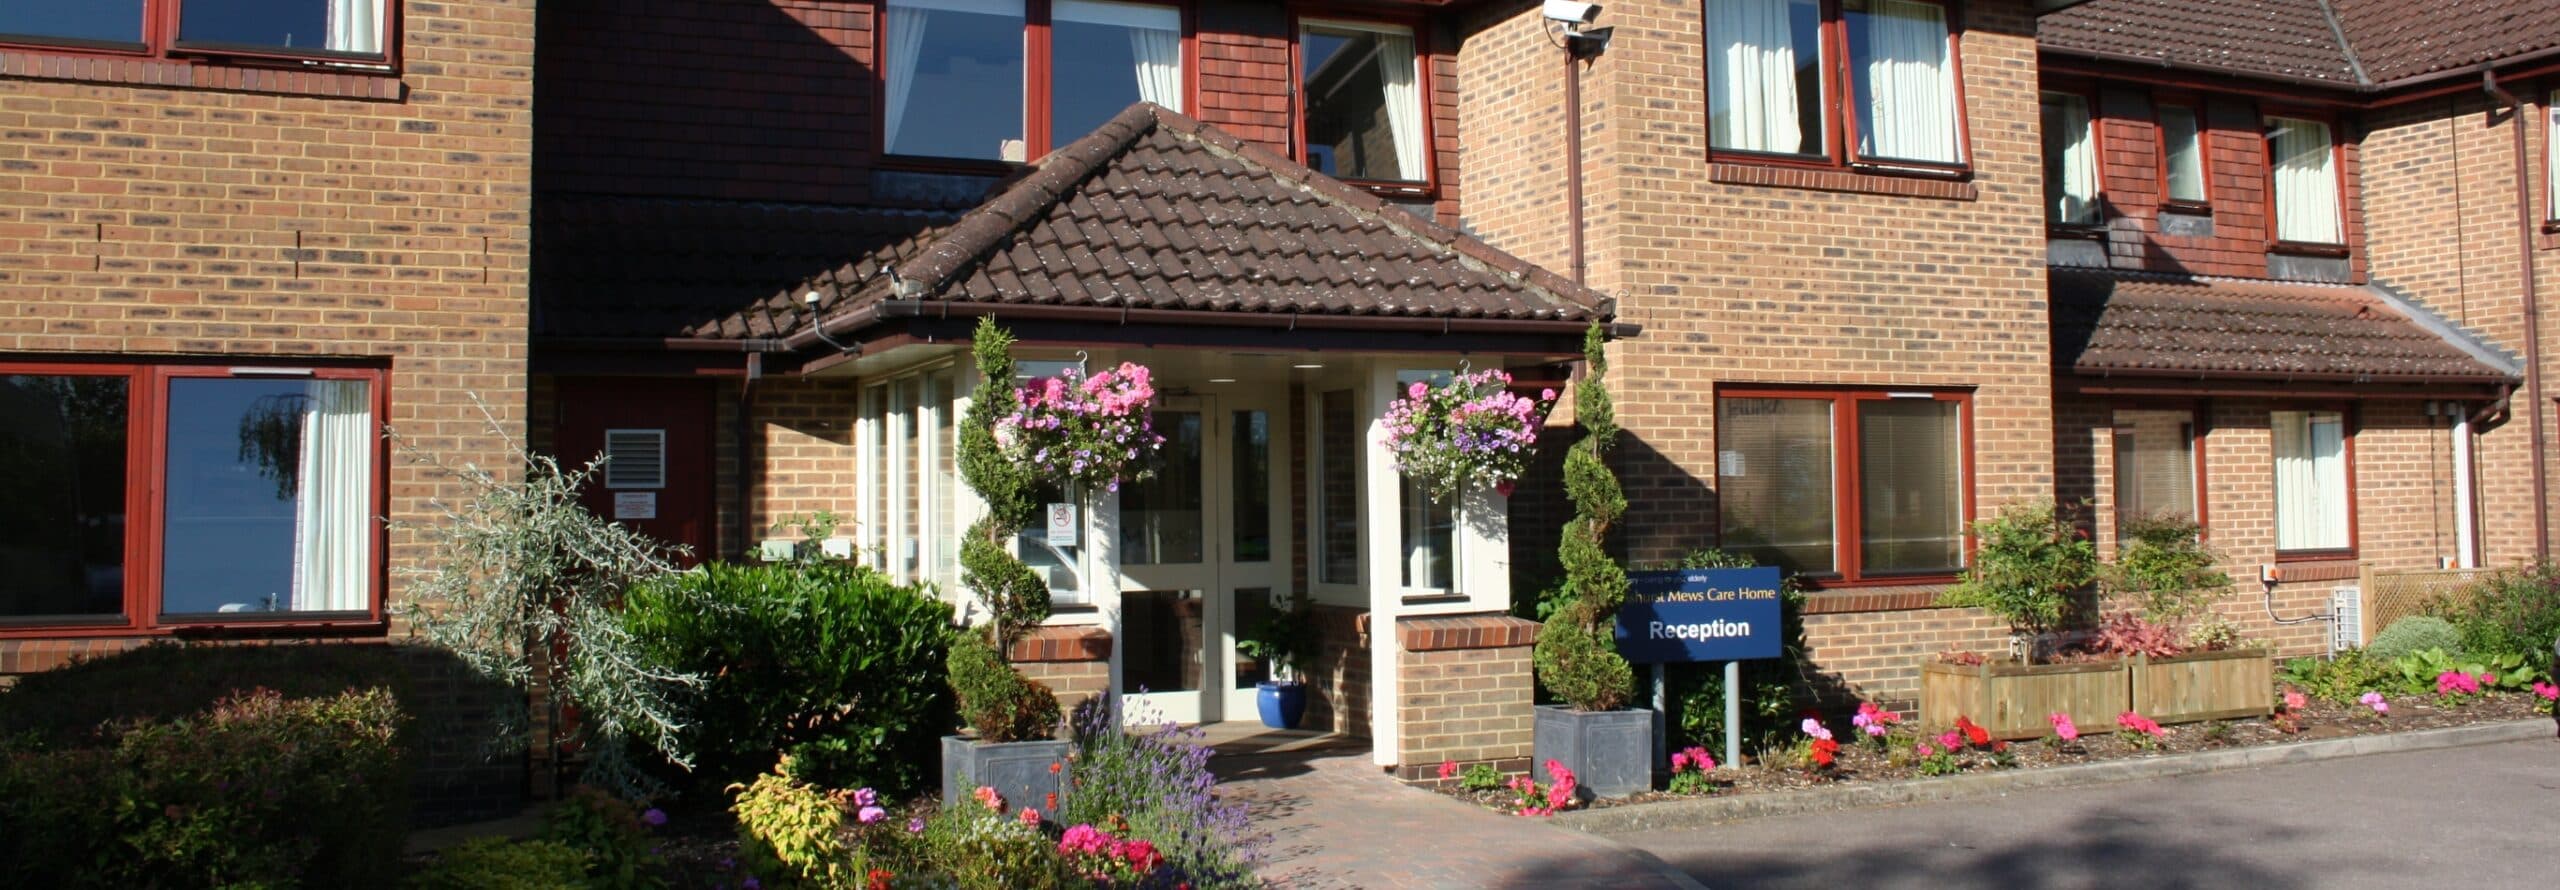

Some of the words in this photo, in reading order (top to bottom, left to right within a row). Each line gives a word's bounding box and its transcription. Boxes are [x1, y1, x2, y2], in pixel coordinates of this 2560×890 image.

[1667, 590, 1704, 603] Mews
[1706, 588, 1735, 601] Care
[1738, 587, 1776, 600] Home
[1649, 618, 1750, 642] Reception
